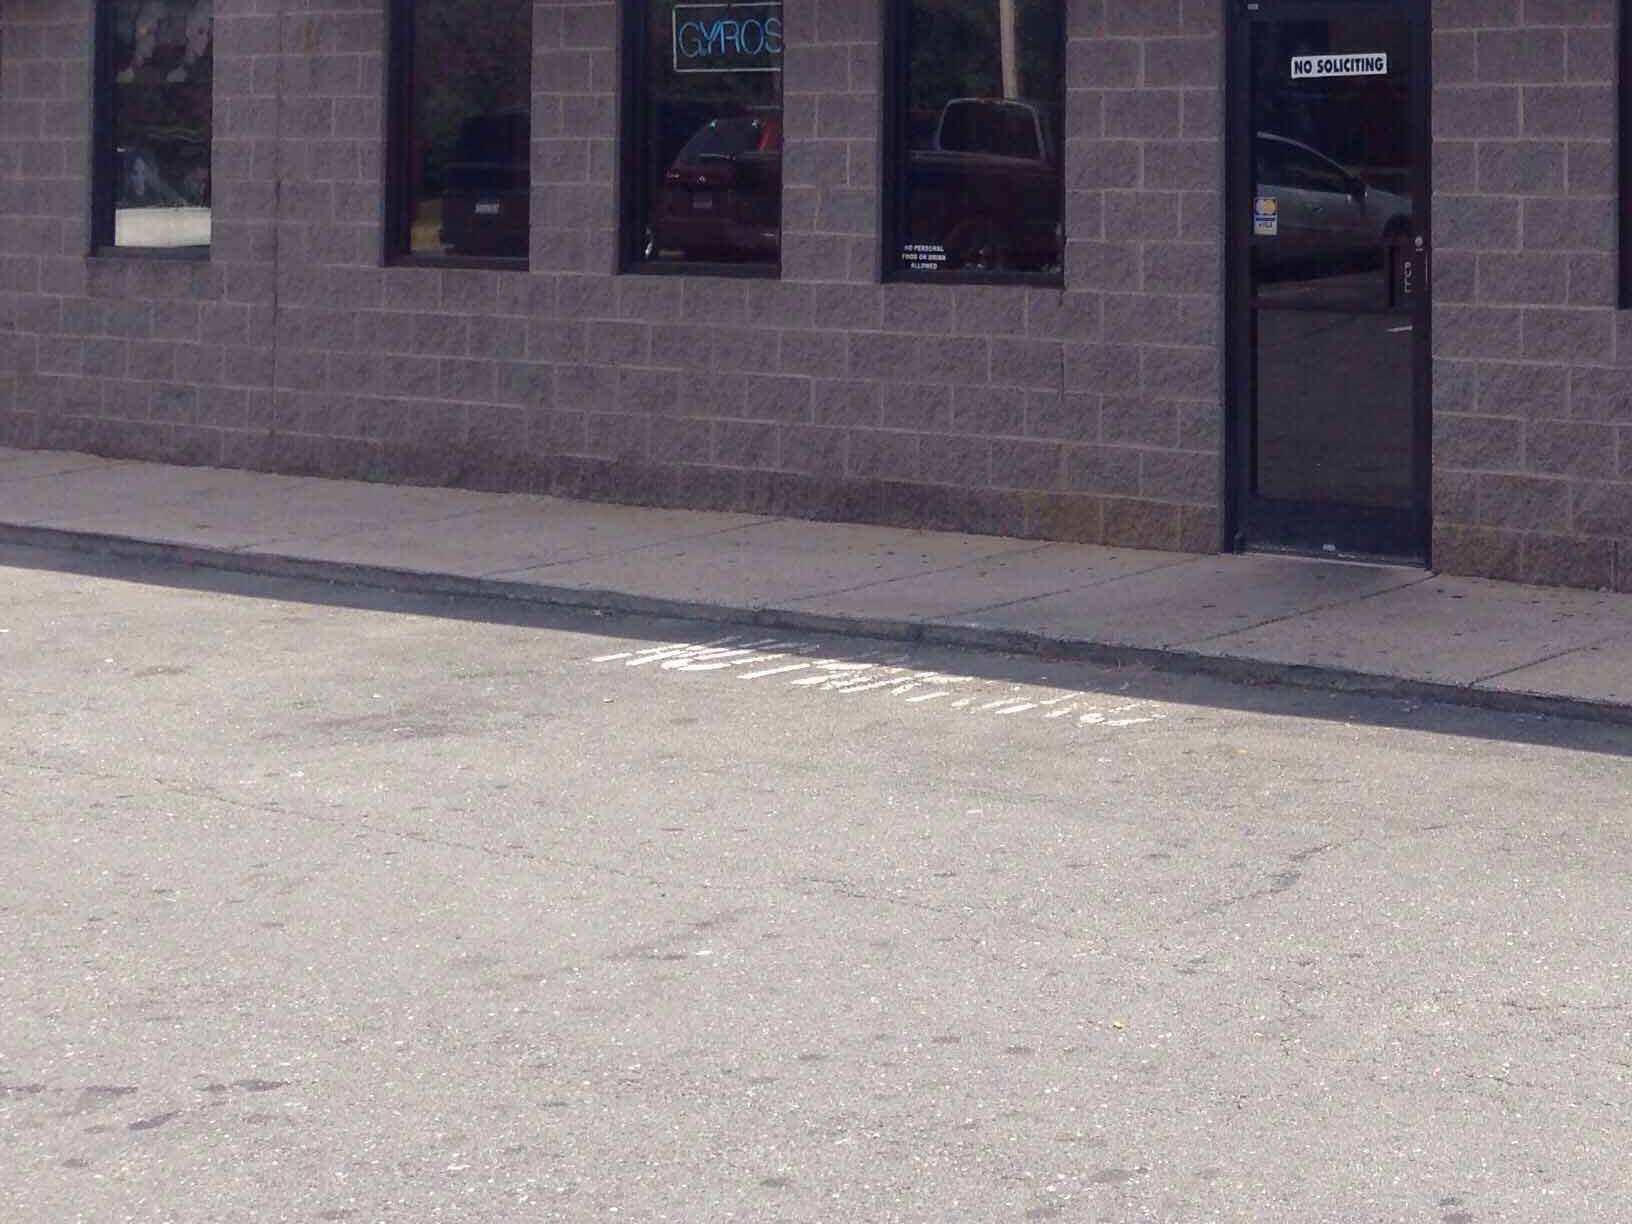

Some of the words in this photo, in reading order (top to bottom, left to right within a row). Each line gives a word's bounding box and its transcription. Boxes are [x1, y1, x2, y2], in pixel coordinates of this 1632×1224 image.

[678, 17, 782, 57] GYROS
[1294, 60, 1312, 74] NO
[1317, 57, 1384, 73] SOLICITING
